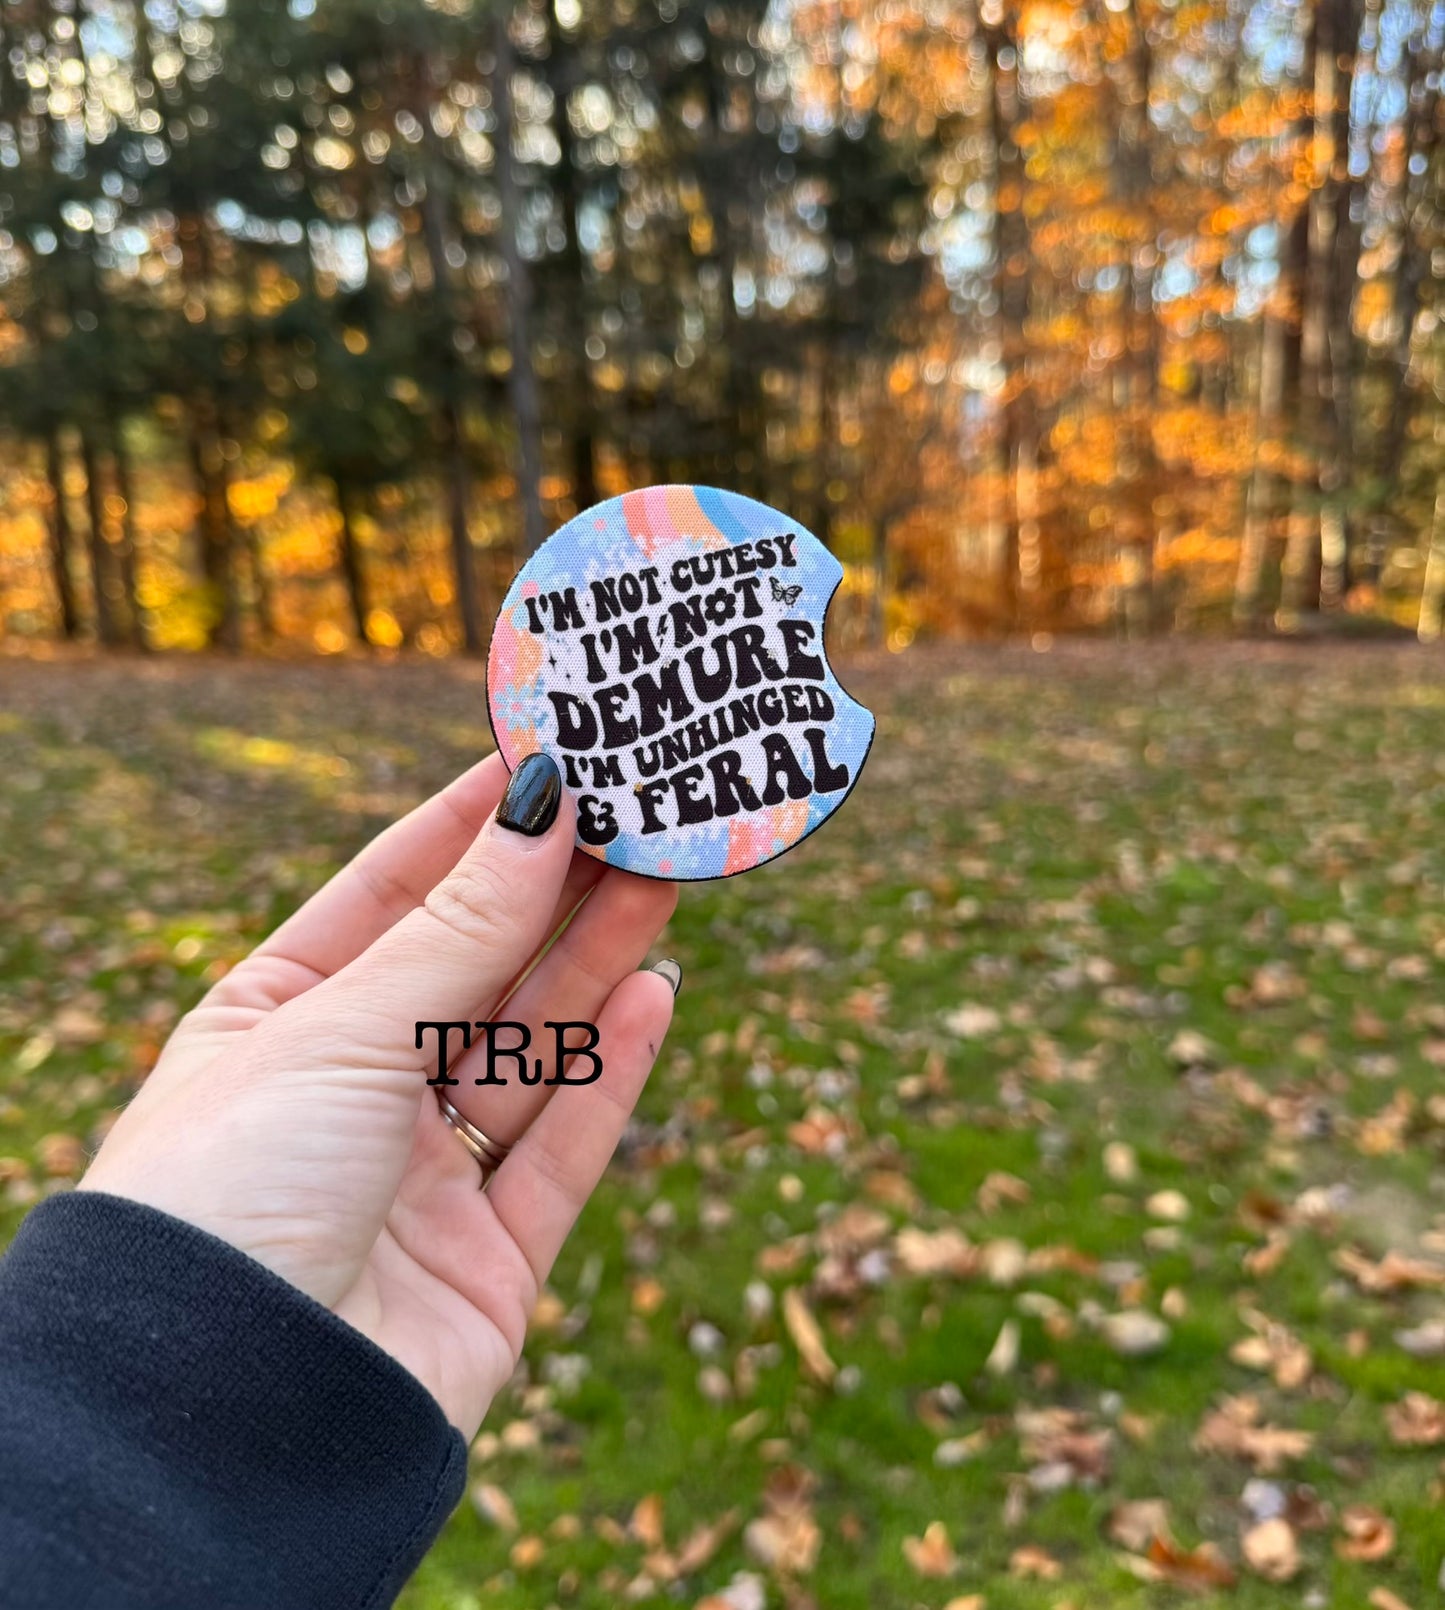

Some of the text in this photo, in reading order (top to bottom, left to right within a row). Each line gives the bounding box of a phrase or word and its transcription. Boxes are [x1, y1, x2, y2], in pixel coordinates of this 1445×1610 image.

[525, 534, 796, 633] I'M NOT CUTESY
[547, 620, 825, 751] DEMURE
[580, 616, 660, 683] I'M
[562, 685, 835, 788] I'M UNHINGED
[577, 728, 849, 845] & FERAL
